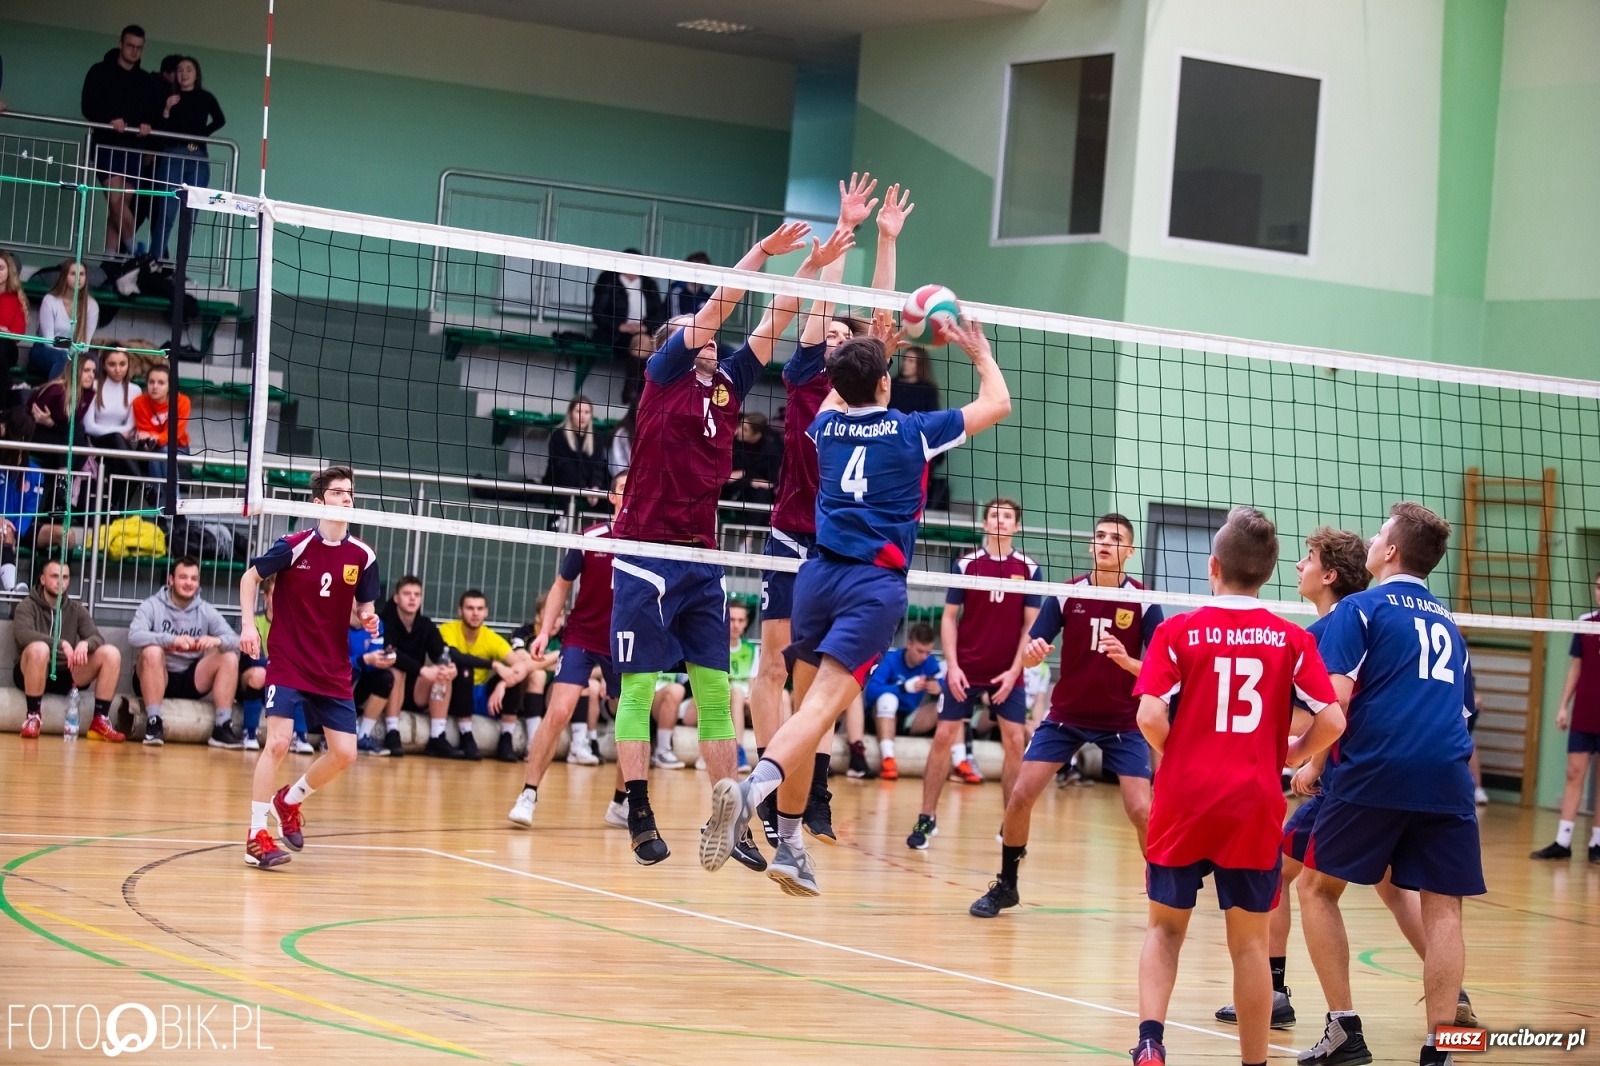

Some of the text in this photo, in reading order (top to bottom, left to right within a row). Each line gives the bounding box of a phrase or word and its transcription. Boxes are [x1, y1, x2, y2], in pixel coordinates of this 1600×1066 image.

[834, 421, 847, 437] LO
[848, 419, 899, 438] RACIBÓRZ
[840, 445, 868, 502] 4
[319, 571, 333, 597] 2
[1386, 594, 1399, 606] II
[1401, 594, 1414, 609] LO
[616, 631, 635, 662] 17
[1089, 617, 1113, 653] 15
[1187, 626, 1287, 648] II LO RACIBÓRZ
[1413, 616, 1455, 685] 12
[266, 684, 276, 708] 2
[1213, 656, 1264, 734] 13
